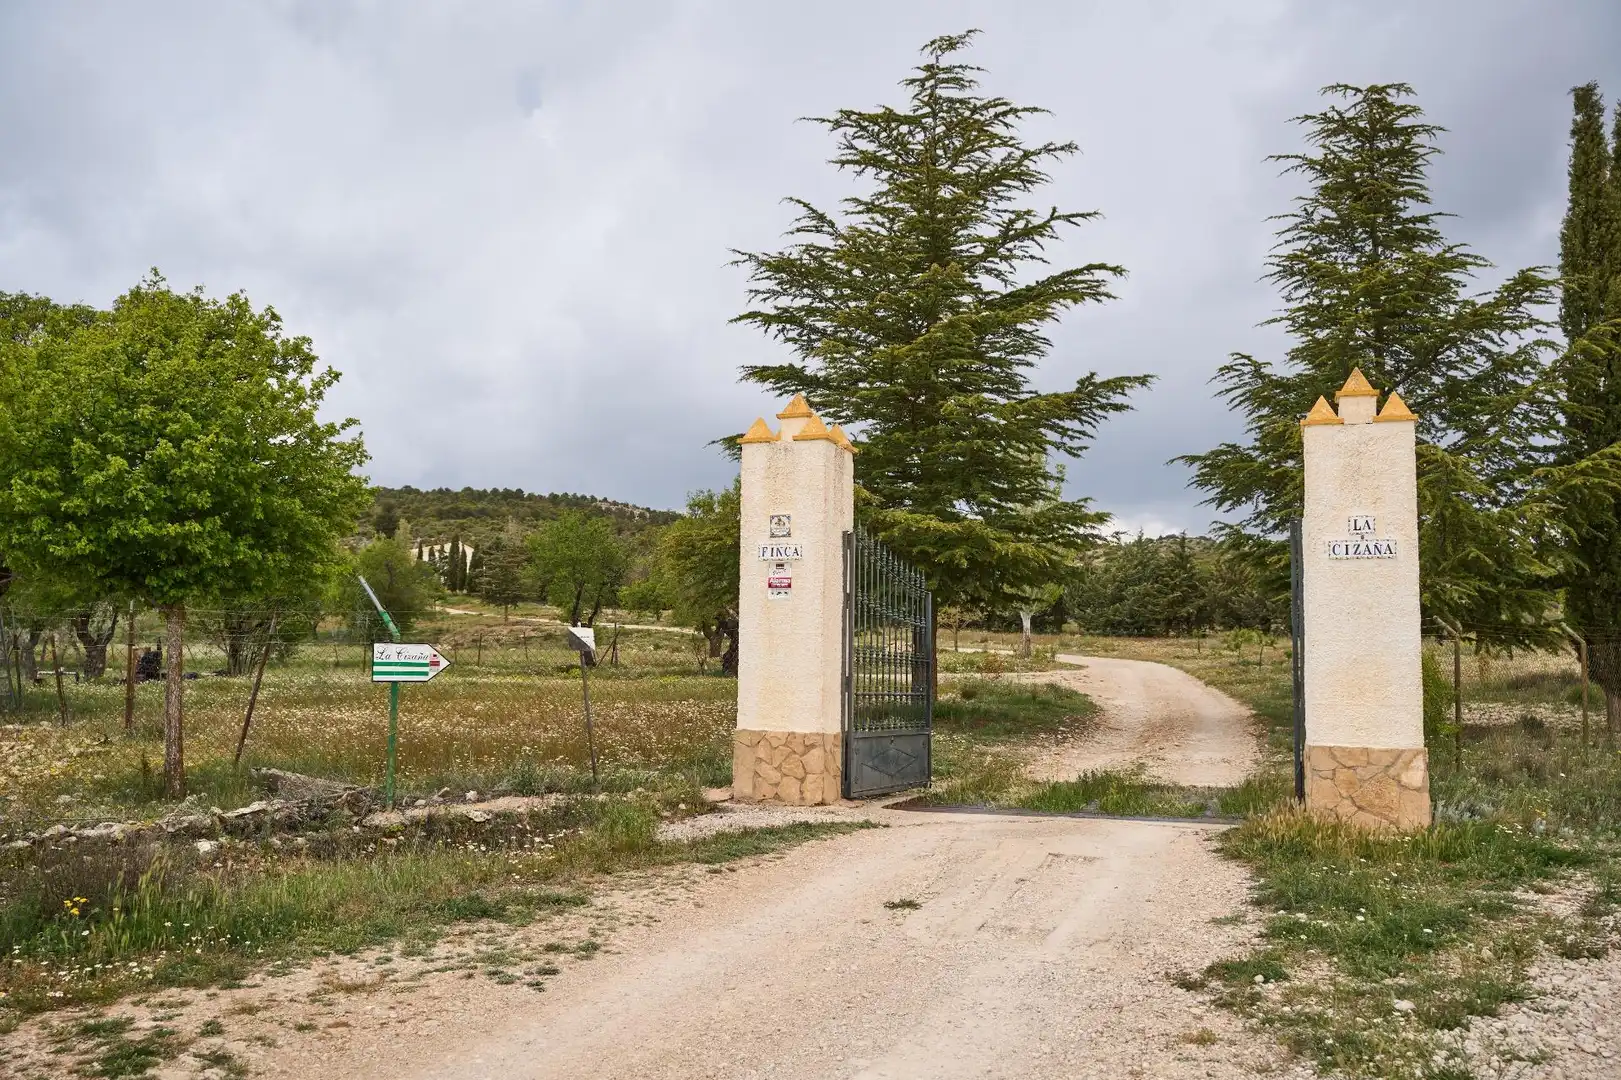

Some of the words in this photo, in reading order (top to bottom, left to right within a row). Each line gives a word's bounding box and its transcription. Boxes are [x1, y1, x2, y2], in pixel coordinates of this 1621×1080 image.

[1353, 518, 1372, 531] LA
[761, 546, 800, 558] FINCA
[1332, 542, 1394, 556] CIZAÑA
[376, 645, 392, 661] La
[395, 646, 429, 661] Cizaña
